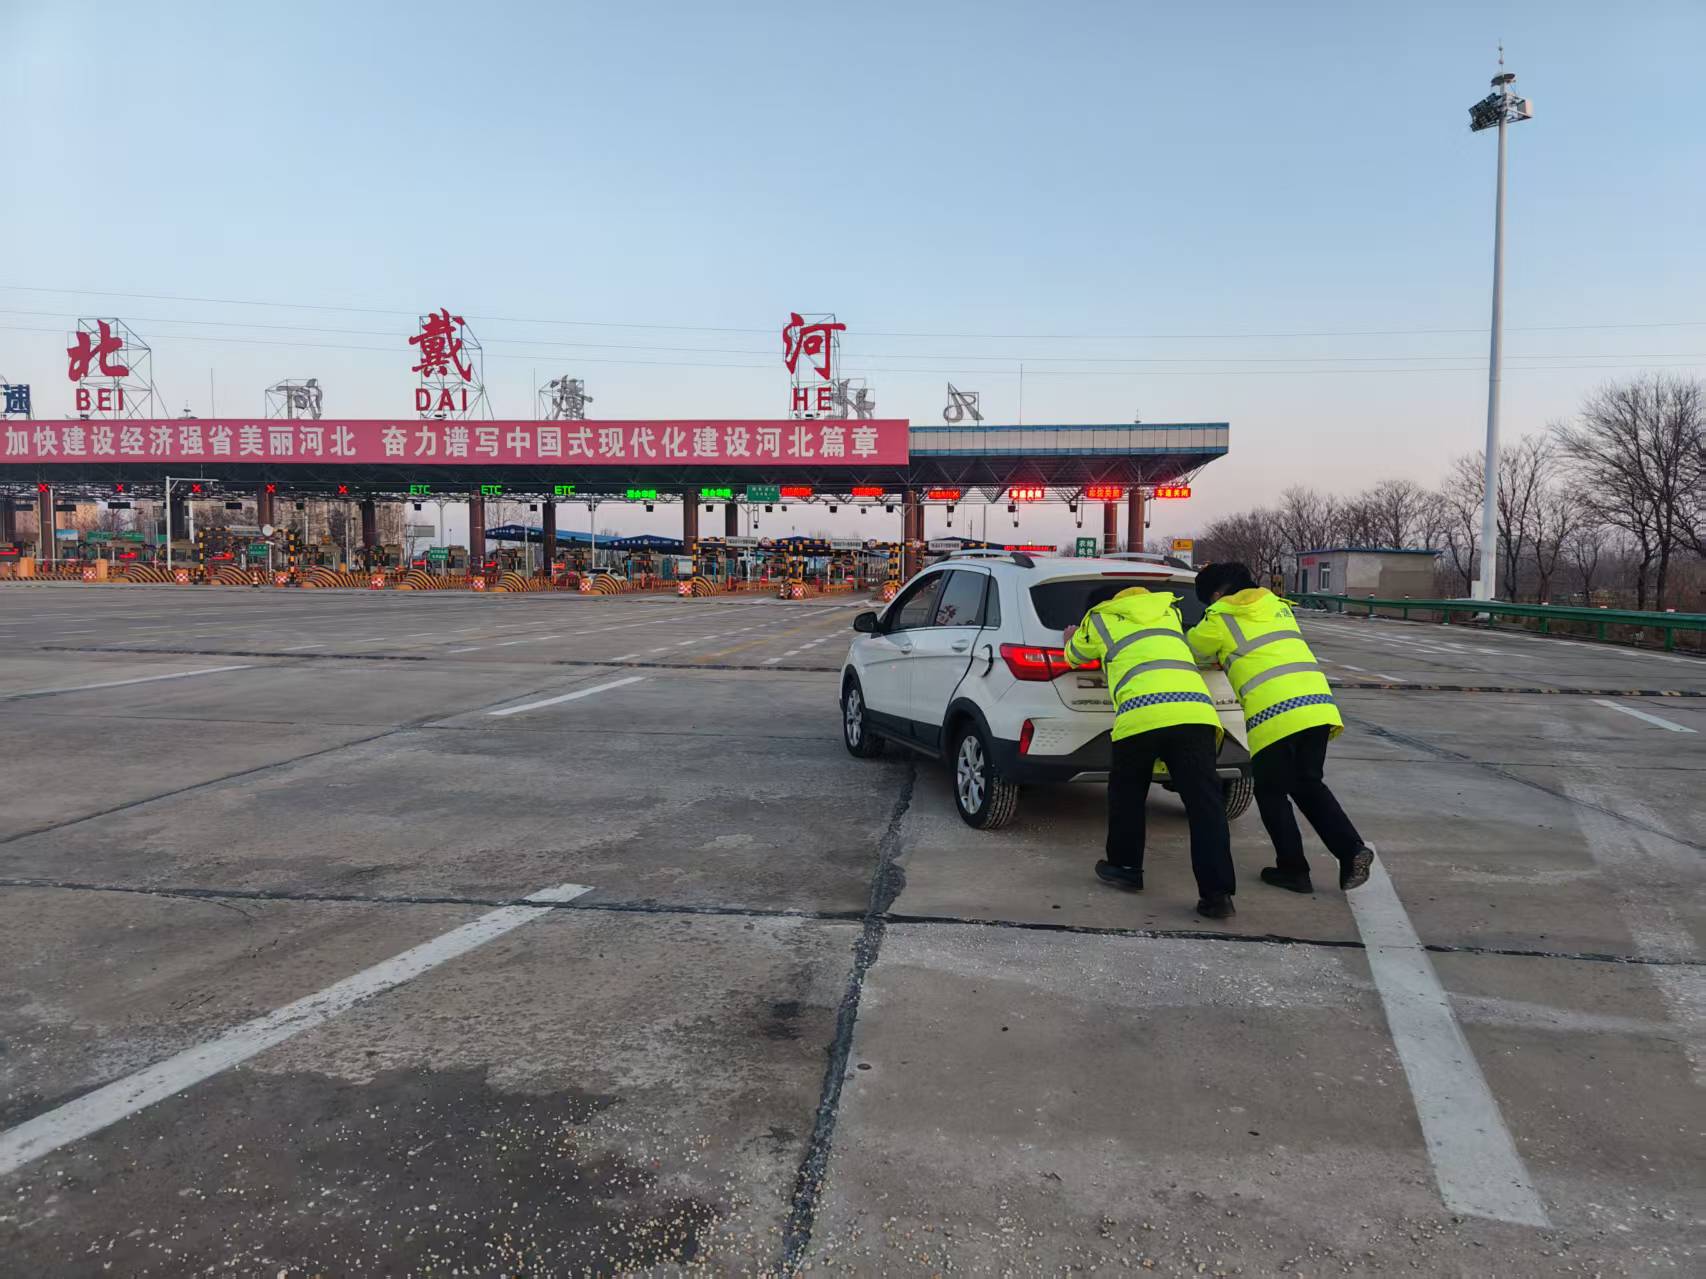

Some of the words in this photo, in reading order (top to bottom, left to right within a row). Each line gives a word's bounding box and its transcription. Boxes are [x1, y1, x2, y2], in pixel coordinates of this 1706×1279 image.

[67, 319, 129, 382] 北
[409, 308, 471, 382] 戴
[782, 312, 846, 380] 河
[75, 388, 124, 411] BEI
[415, 388, 467, 411] DAI
[793, 387, 832, 411] HE
[5, 425, 356, 457] 加快建设经济强省美丽河北
[382, 425, 879, 458] 奋力谱写中国式现代化建设河北篇章
[410, 485, 431, 495] ETC
[481, 485, 503, 495] ETC
[554, 485, 576, 496] ETC
